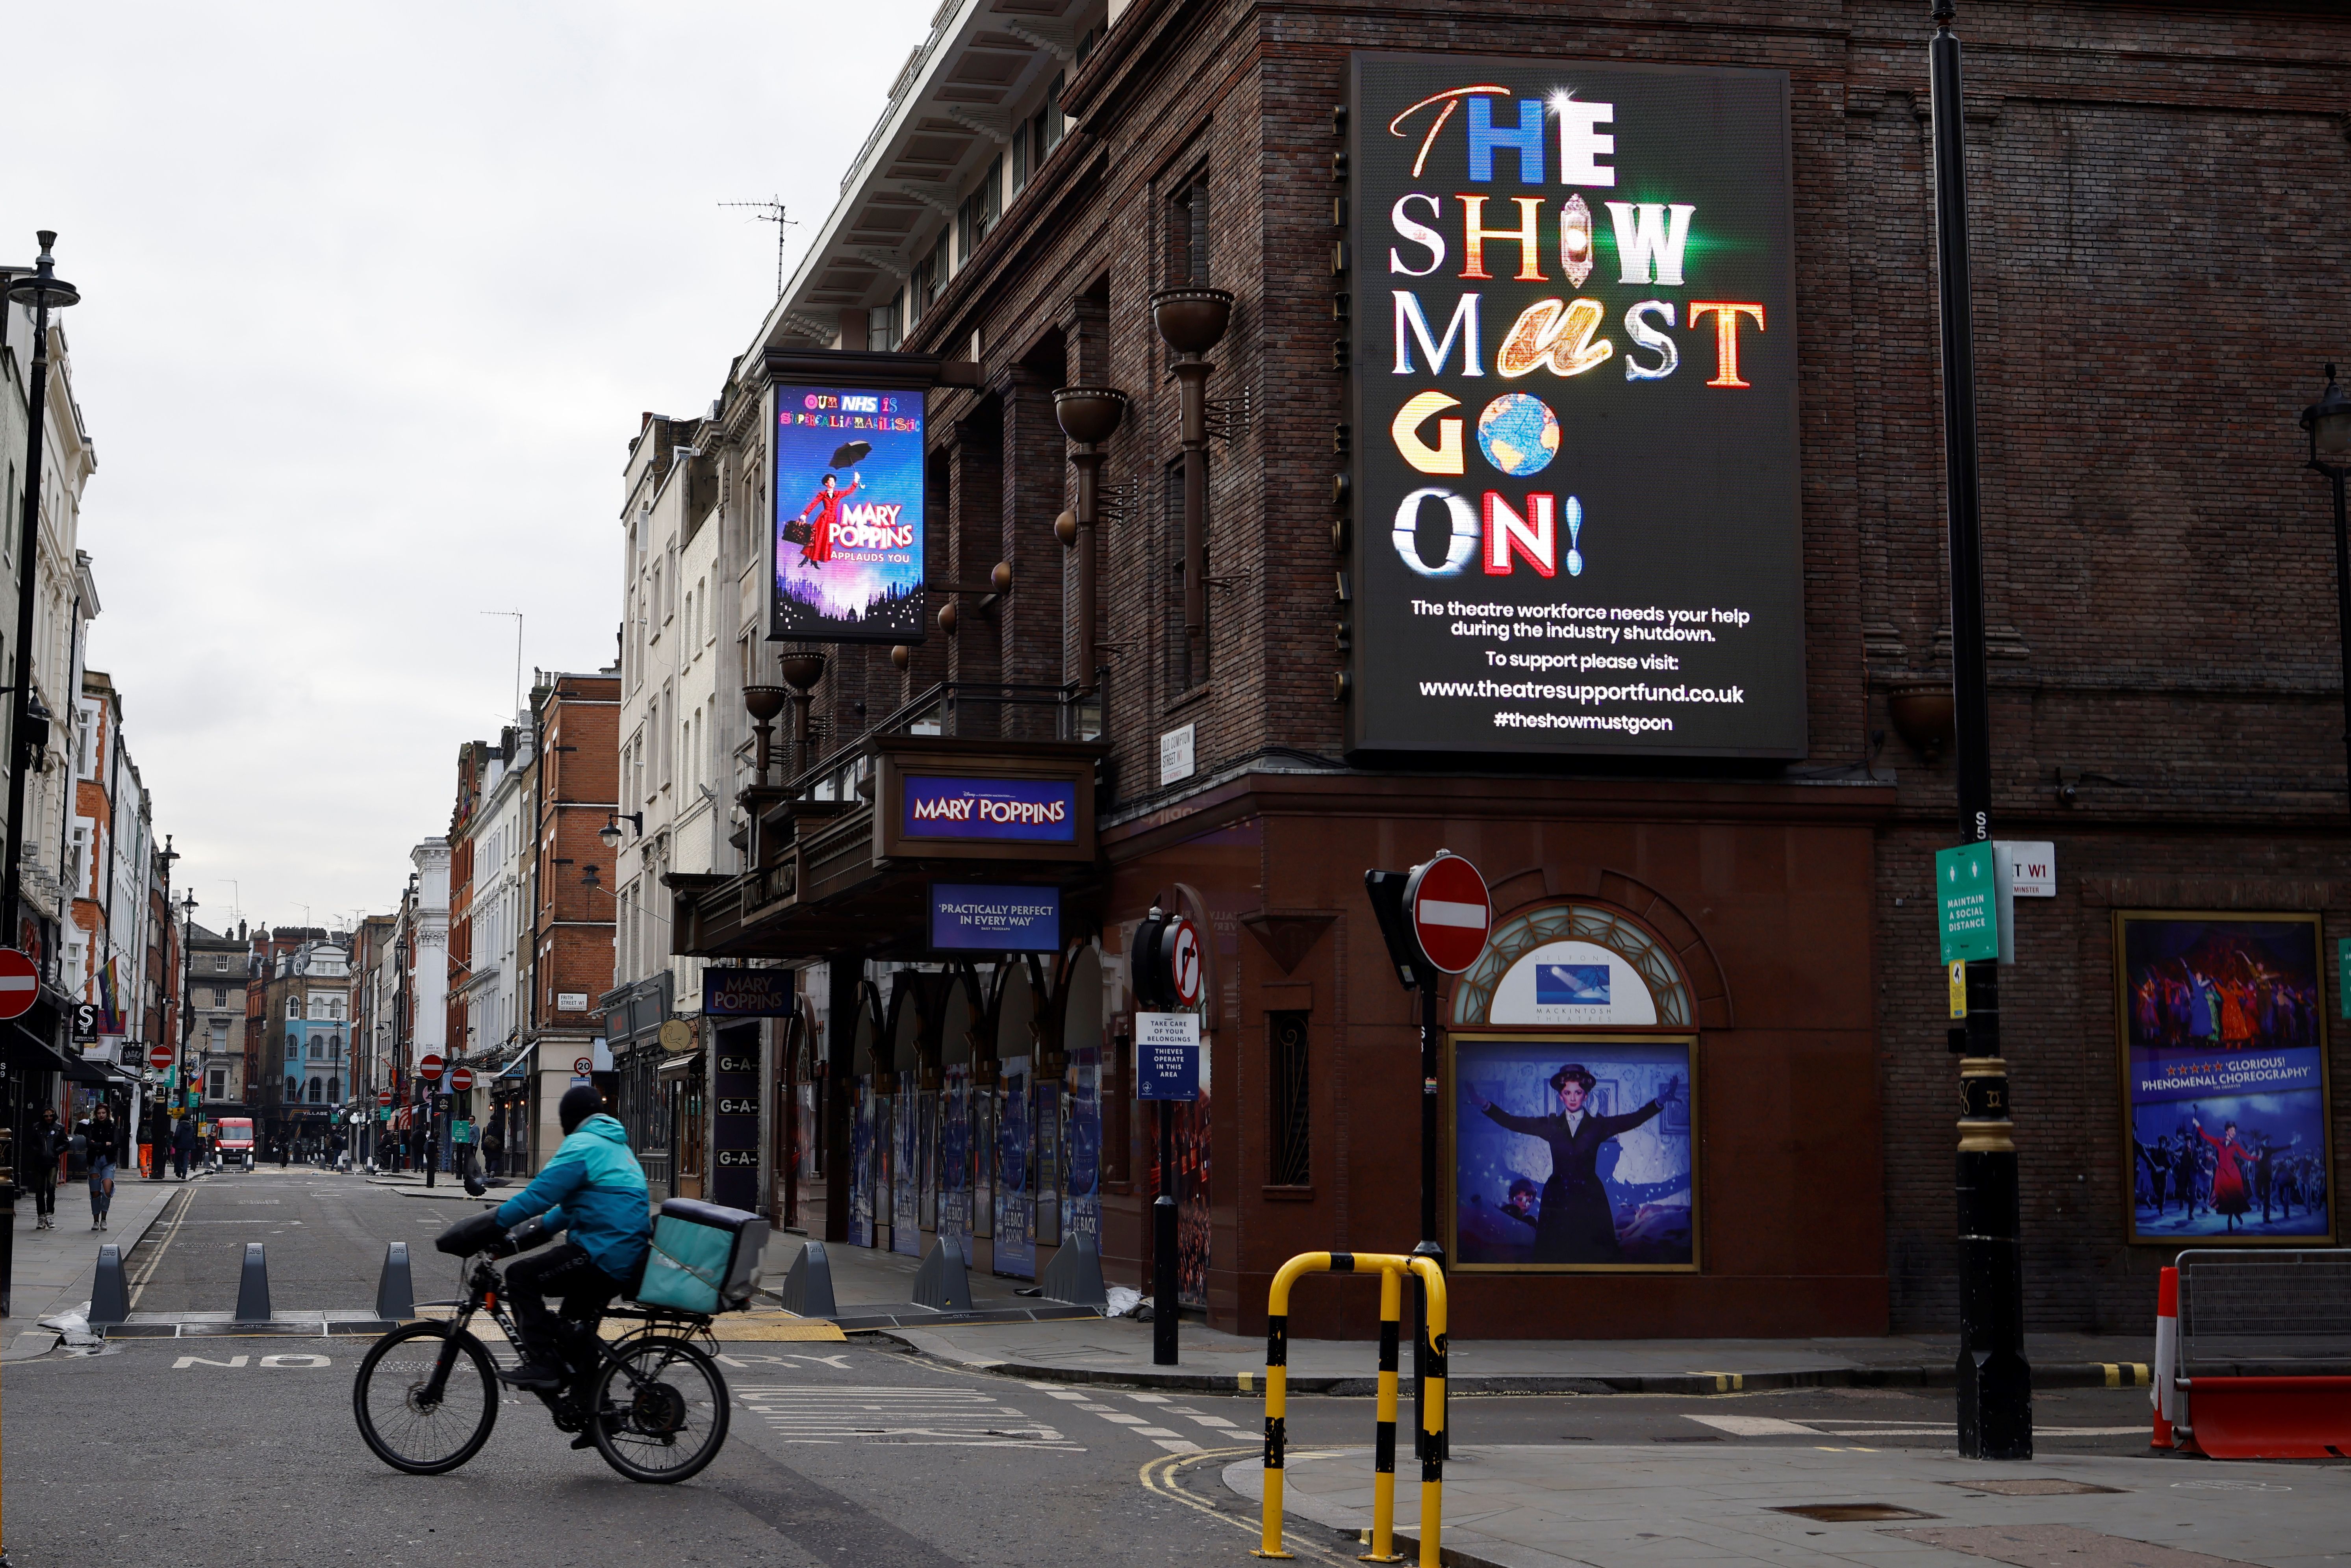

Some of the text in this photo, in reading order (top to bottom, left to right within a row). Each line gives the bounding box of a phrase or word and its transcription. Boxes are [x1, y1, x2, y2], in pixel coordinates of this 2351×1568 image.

[1390, 84, 1615, 186] THE
[1391, 193, 1696, 288] SHOW
[842, 397, 877, 411] NHS
[1392, 391, 1560, 475] GO
[842, 502, 901, 526] MARY
[829, 523, 913, 550] POPPINS
[1392, 488, 1582, 577] ON!
[831, 550, 910, 563] APPLAUDS YOU
[1411, 600, 1750, 628] The theatre workforce needs your help
[1451, 621, 1716, 644] during the industry shutdown.
[1486, 652, 1679, 673] To support please visit:
[1420, 680, 1744, 704] www.theatresupportfund.co.uk
[1494, 712, 1673, 734] #theshowmustgoon
[1171, 730, 1190, 749] COMPTON
[1163, 749, 1182, 768] STREET W1
[914, 798, 1065, 825] MARY POPPINS
[2028, 863, 2046, 878] W1
[1948, 894, 1984, 909] MAINTAIN
[1011, 906, 1053, 916] PERFECT
[1950, 906, 1984, 920] A SOCIAL
[960, 916, 972, 925] IN
[975, 916, 1007, 925] EVERY
[1949, 917, 1985, 932] DISTANCE
[726, 976, 773, 993] MARY
[714, 991, 782, 1010] POPPINS
[2142, 1074, 2217, 1092] PHENOMENAL
[949, 1190, 961, 1205] WE'LL
[1007, 1194, 1022, 1210] WE'LL
[1076, 1197, 1093, 1214] WE'LL
[947, 1206, 963, 1221] BE BACK
[1005, 1211, 1024, 1228] BE BACK
[947, 1221, 962, 1237] SOON!
[1073, 1216, 1096, 1234] BE BACK
[1006, 1228, 1023, 1246] SOON!
[172, 1354, 331, 1368] NO
